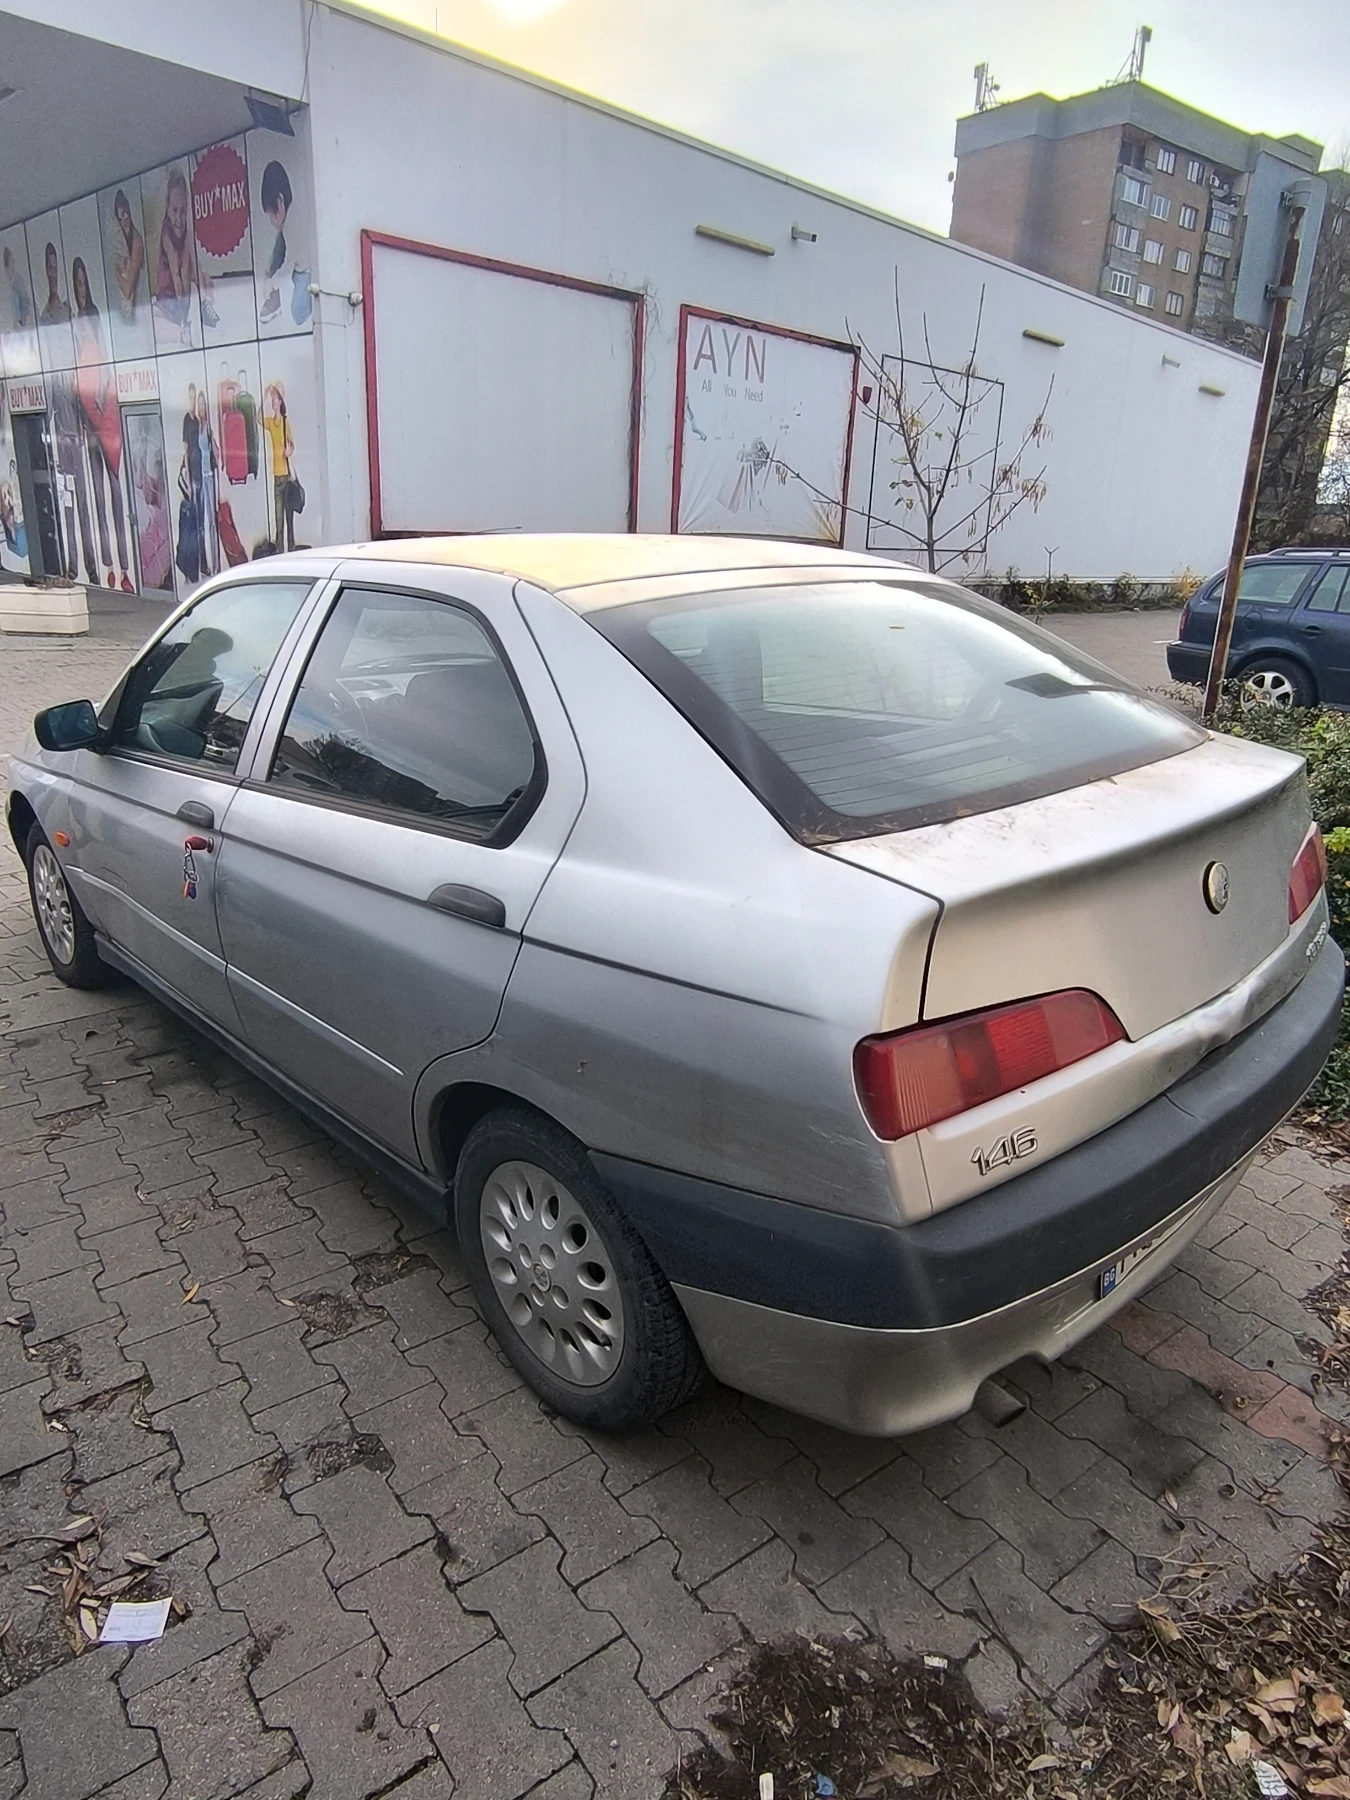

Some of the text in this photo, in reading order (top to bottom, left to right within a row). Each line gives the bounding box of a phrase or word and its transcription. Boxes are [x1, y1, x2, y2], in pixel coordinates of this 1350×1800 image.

[693, 323, 766, 384] AYN
[701, 378, 764, 403] All You Need
[970, 1124, 1039, 1176] 146
[1103, 1267, 1116, 1287] BG
